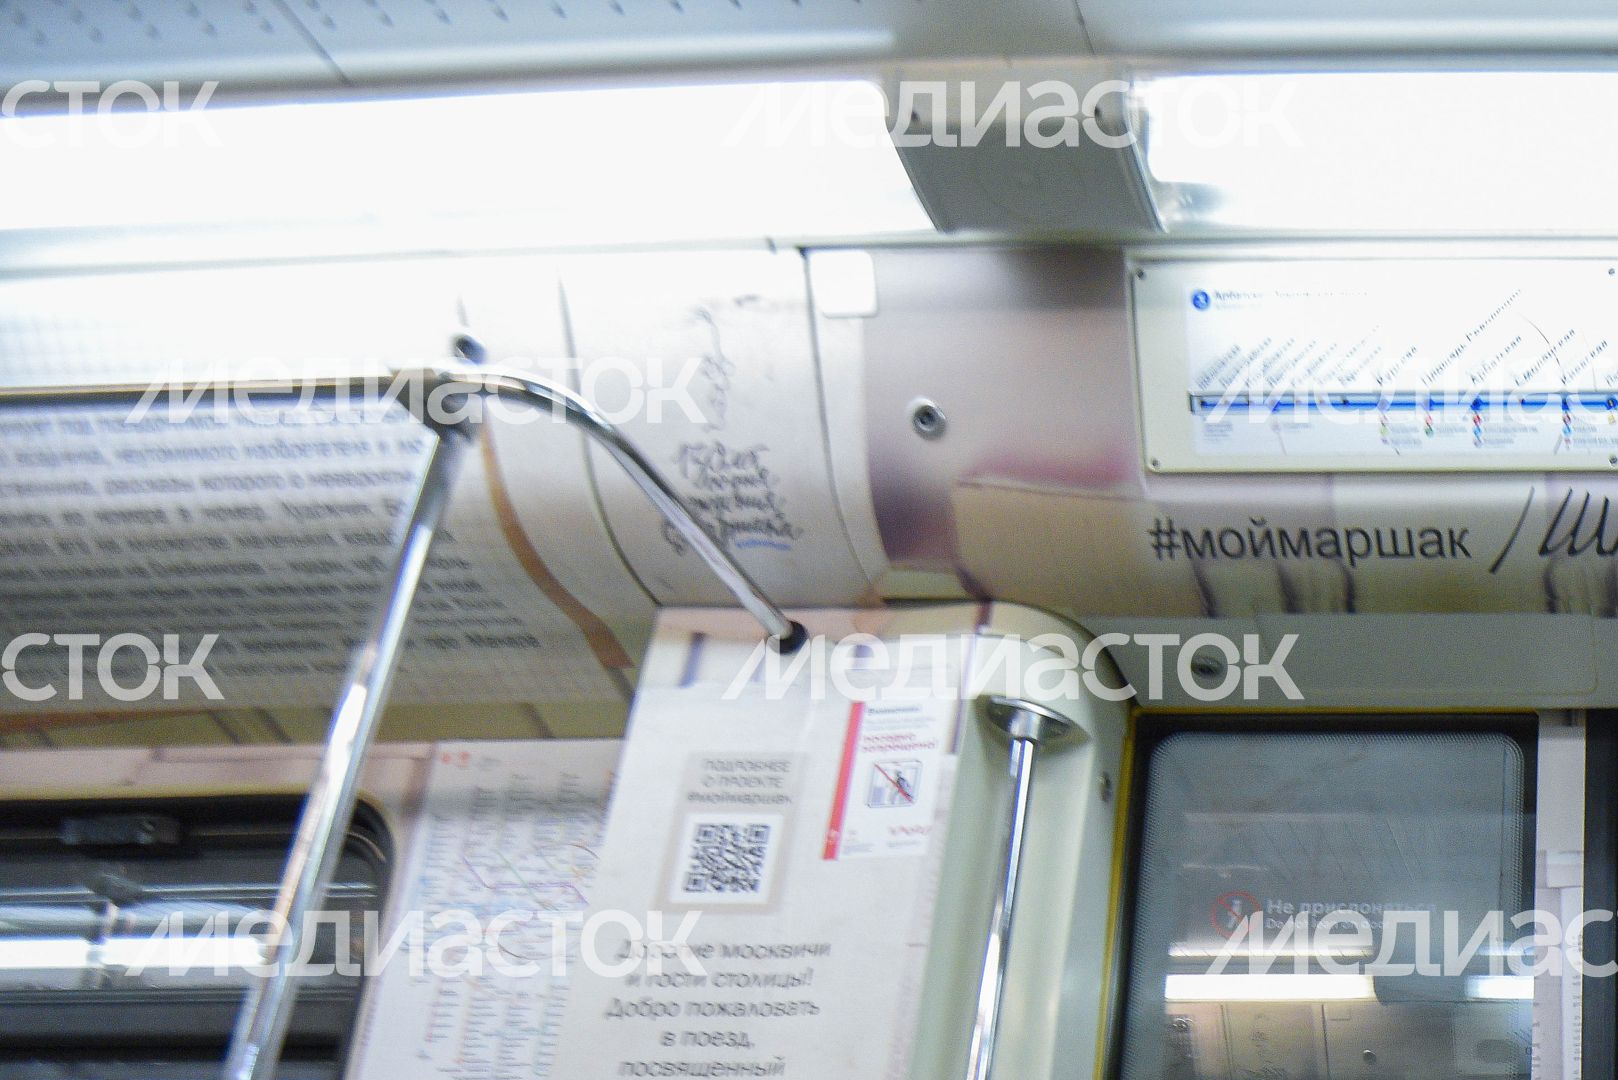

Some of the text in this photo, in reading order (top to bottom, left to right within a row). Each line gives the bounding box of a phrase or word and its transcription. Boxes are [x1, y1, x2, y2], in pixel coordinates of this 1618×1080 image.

[1148, 517, 1473, 568] #моймаршак
[1266, 898, 1294, 914] Не
[719, 943, 831, 959] москвичи
[646, 972, 706, 988] гости
[712, 968, 814, 989] столицы!
[605, 998, 820, 1020] Добро пожаловать
[661, 1031, 755, 1049] в поезд,
[618, 1056, 785, 1078] посвященный
